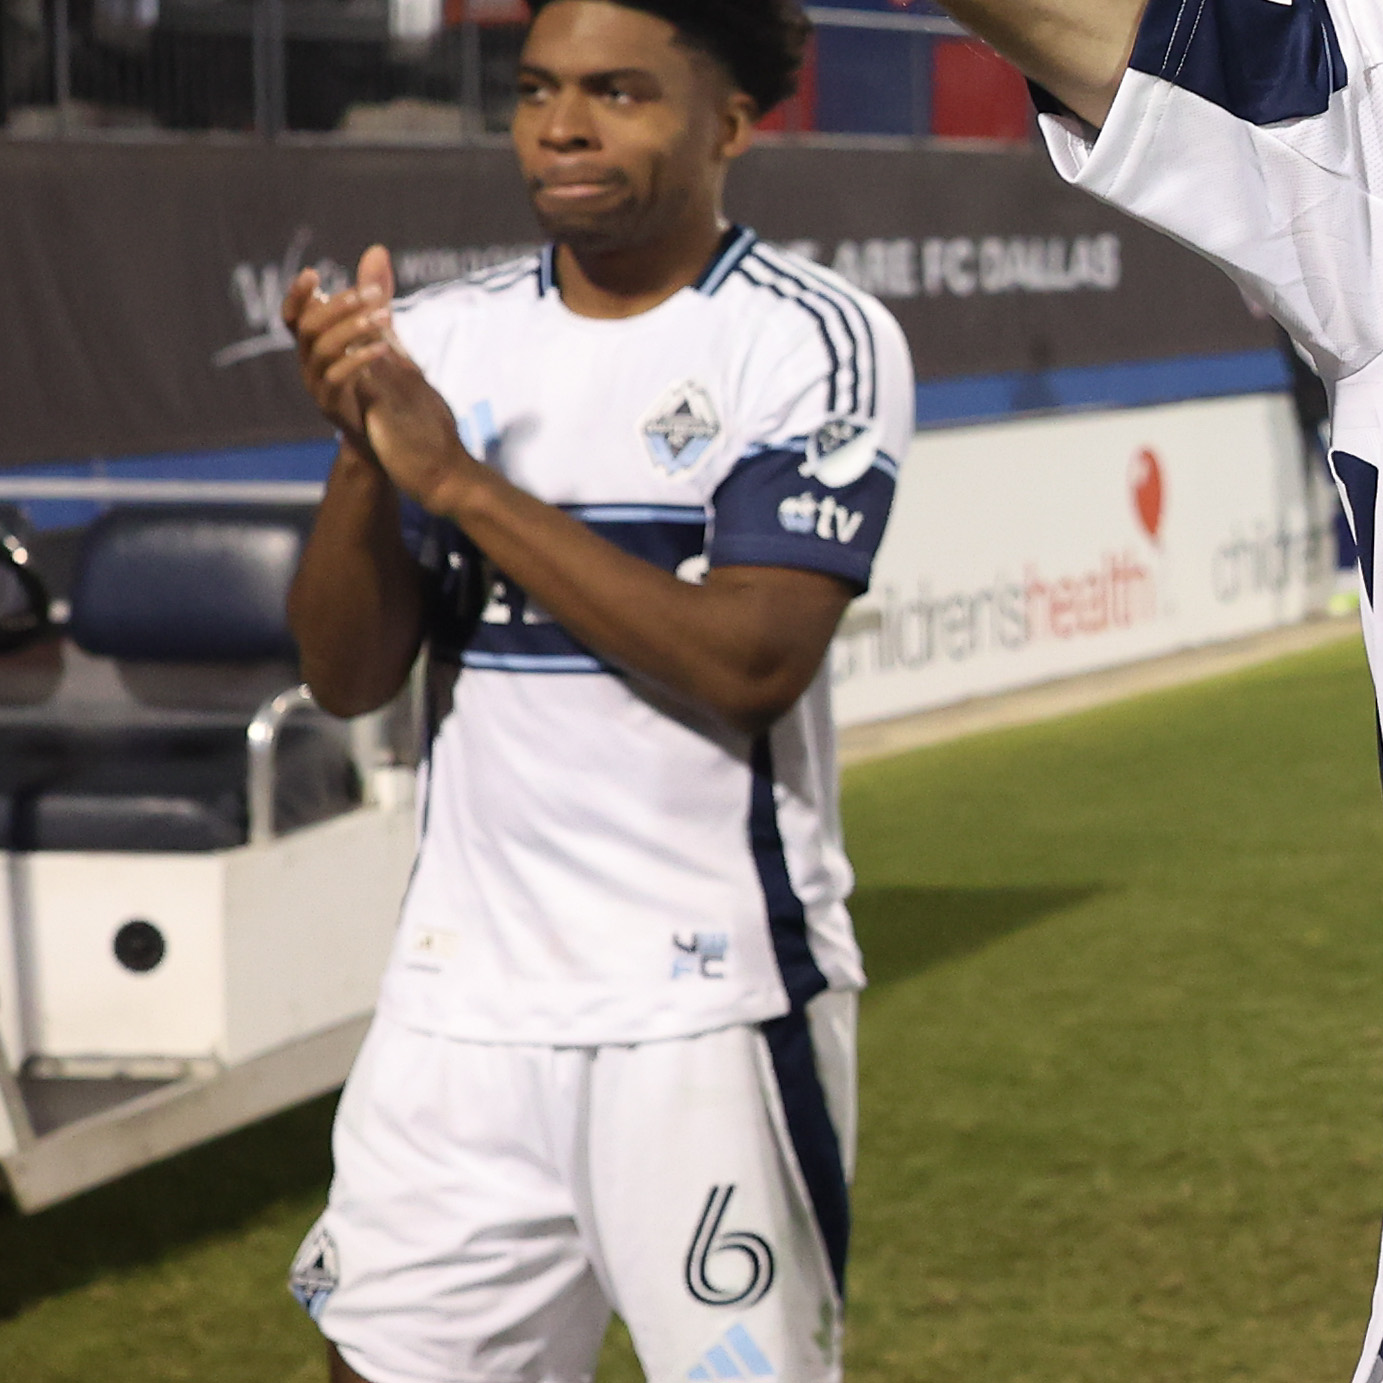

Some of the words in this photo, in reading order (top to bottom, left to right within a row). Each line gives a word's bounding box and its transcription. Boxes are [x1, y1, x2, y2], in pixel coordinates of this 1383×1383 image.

[921, 237, 977, 297] FC
[979, 232, 1122, 295] DALLAS
[816, 496, 864, 544] tv
[684, 1184, 775, 1307] 6
